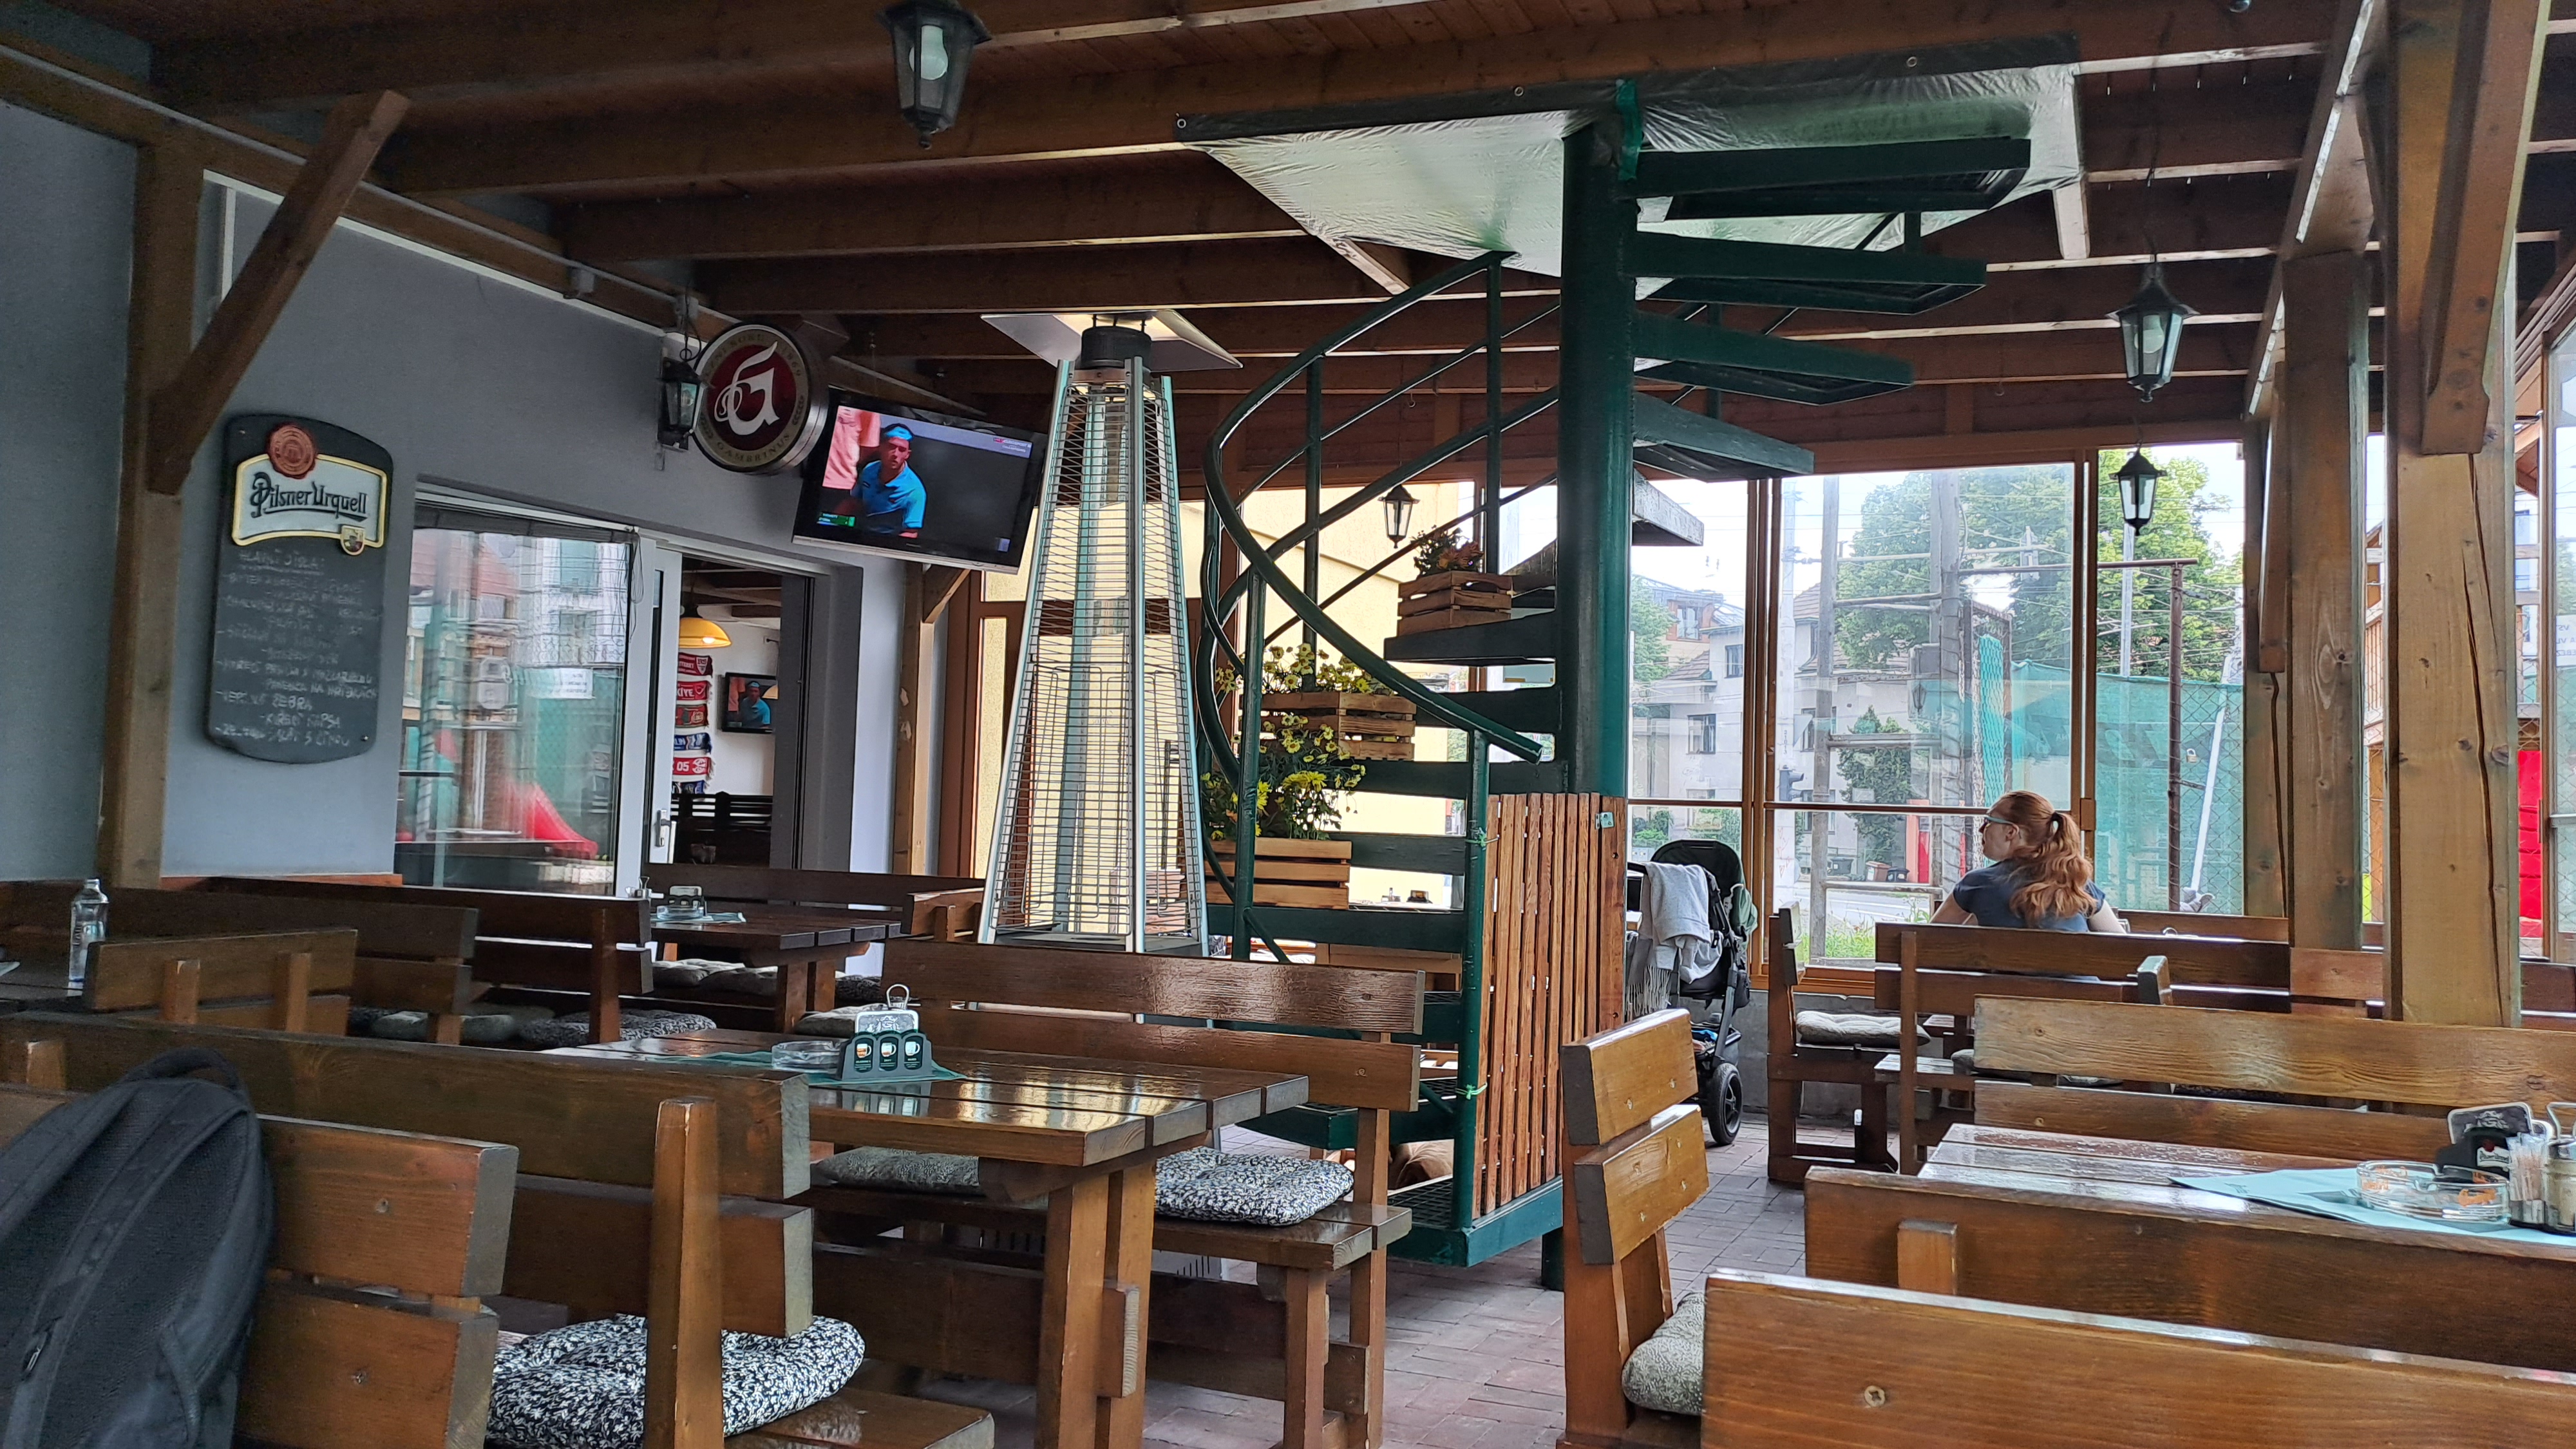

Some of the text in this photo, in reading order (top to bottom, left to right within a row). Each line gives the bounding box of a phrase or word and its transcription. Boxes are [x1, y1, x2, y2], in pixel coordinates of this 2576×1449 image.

[717, 434, 790, 462] GAMBRINUS
[250, 471, 368, 519] Pilsner Urquell
[676, 761, 690, 772] 05
